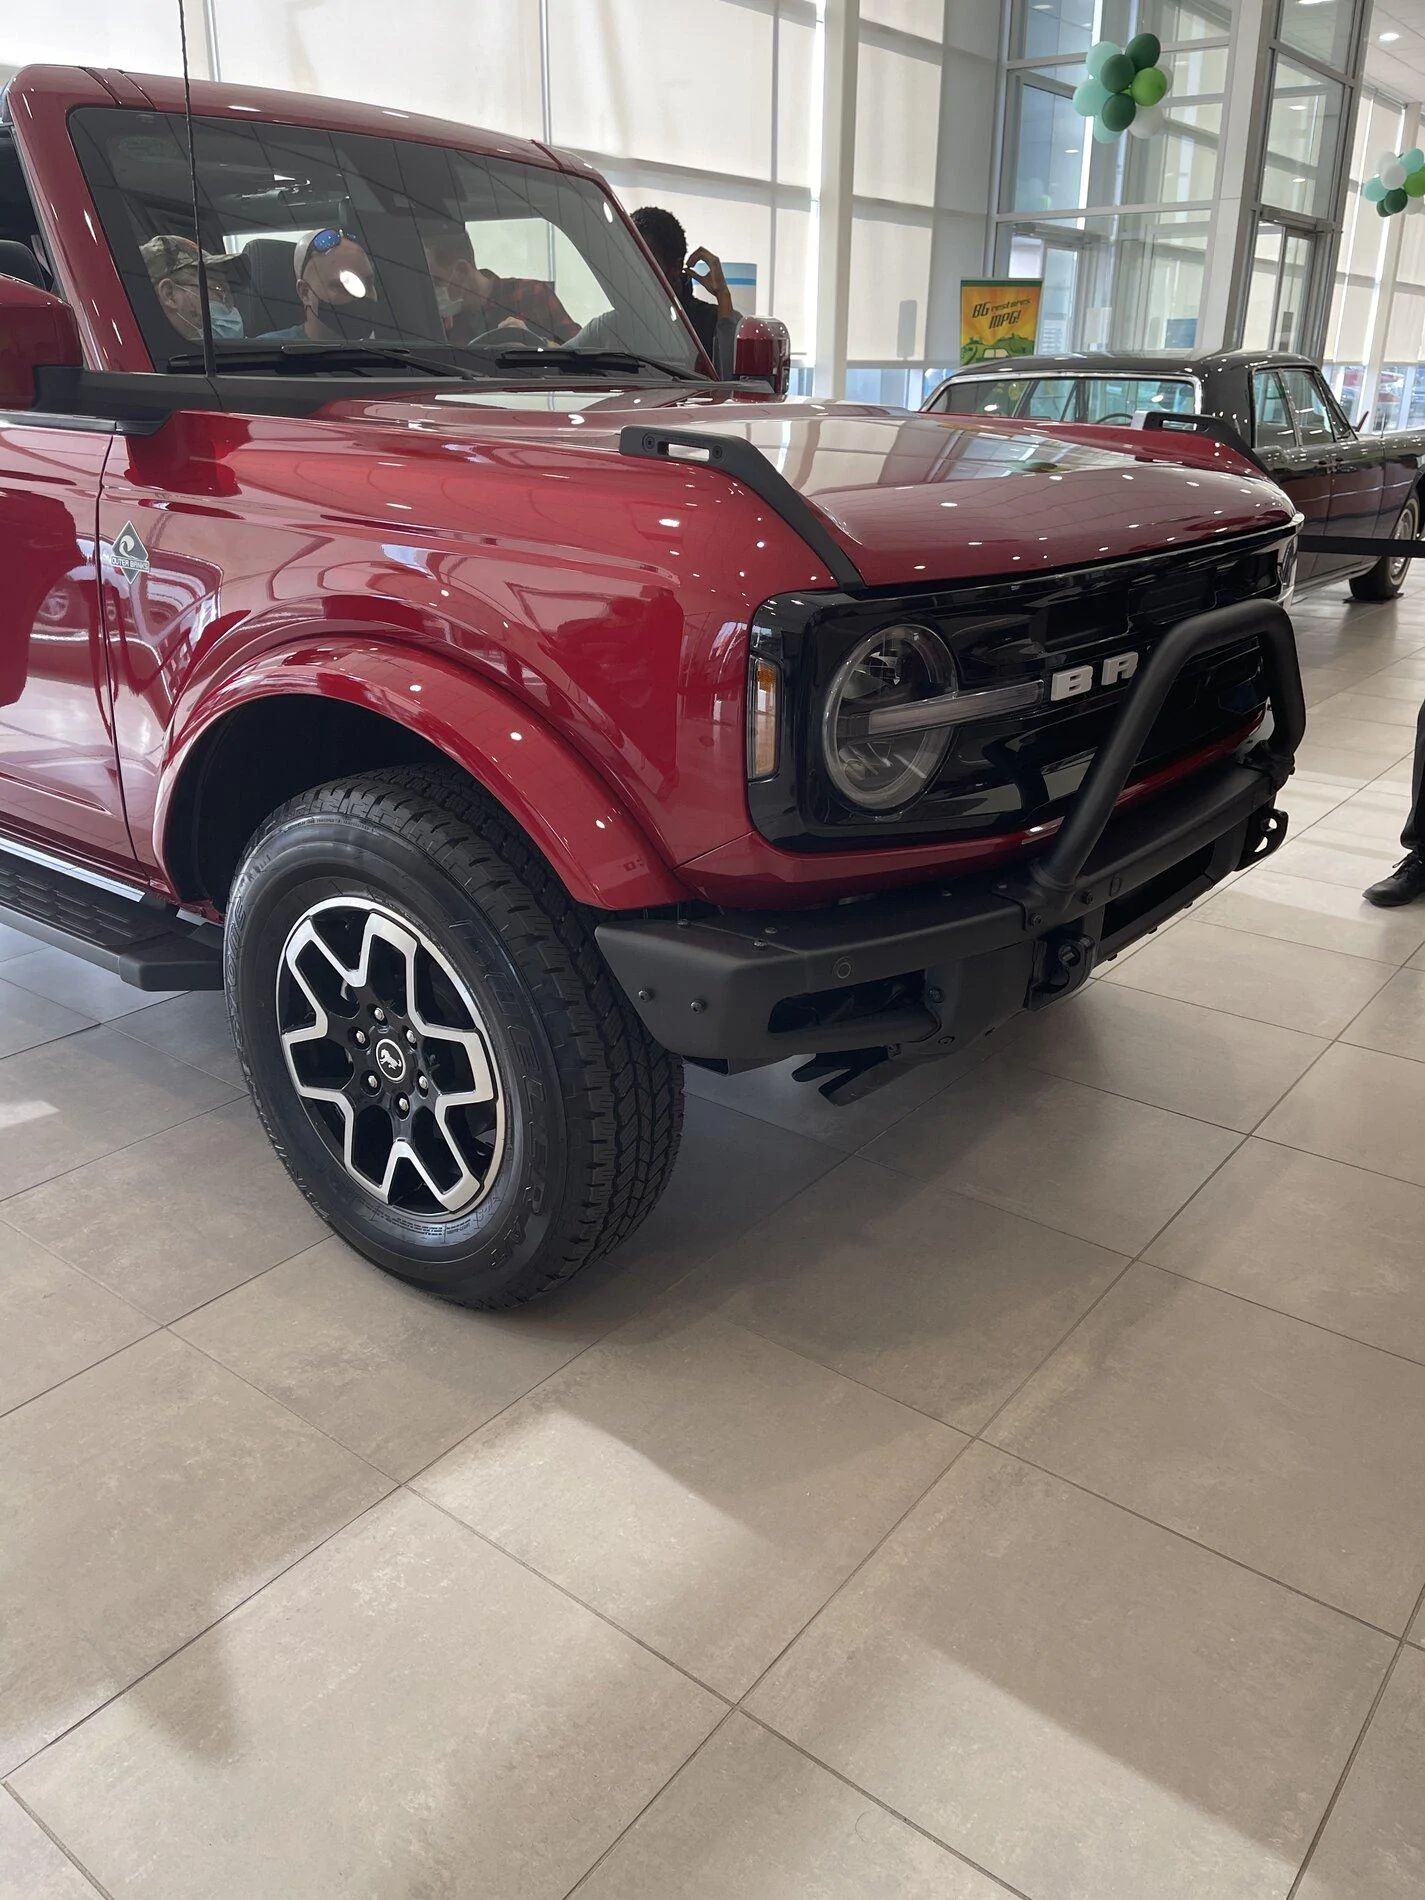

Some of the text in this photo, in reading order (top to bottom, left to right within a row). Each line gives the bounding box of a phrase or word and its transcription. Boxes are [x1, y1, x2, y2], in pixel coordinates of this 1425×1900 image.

[989, 310, 1021, 329] MPG!
[111, 557, 149, 570] OUTER BANKS
